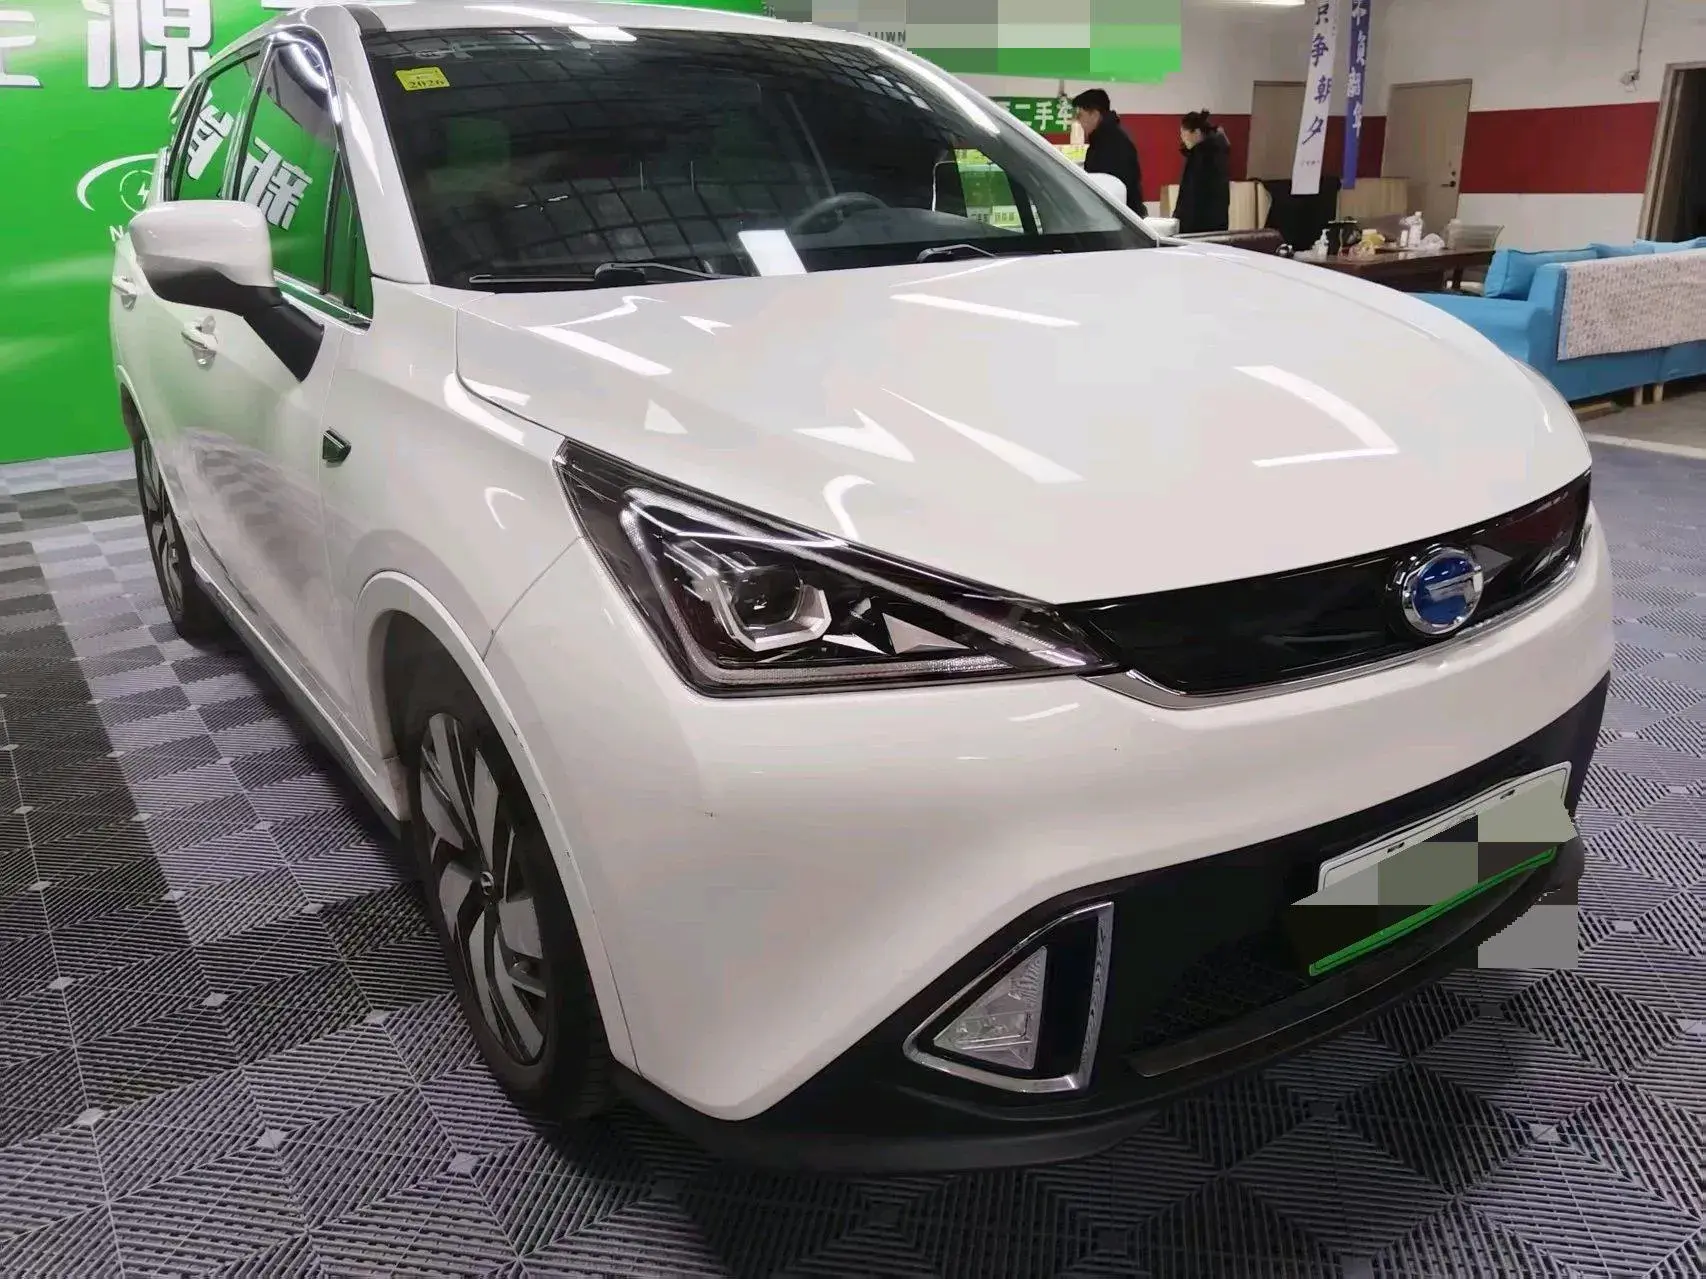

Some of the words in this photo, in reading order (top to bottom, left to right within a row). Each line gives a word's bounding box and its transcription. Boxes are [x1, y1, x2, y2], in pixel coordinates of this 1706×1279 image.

[996, 101, 1074, 132] 二手车
[1302, 3, 1332, 145] 只争朝夕
